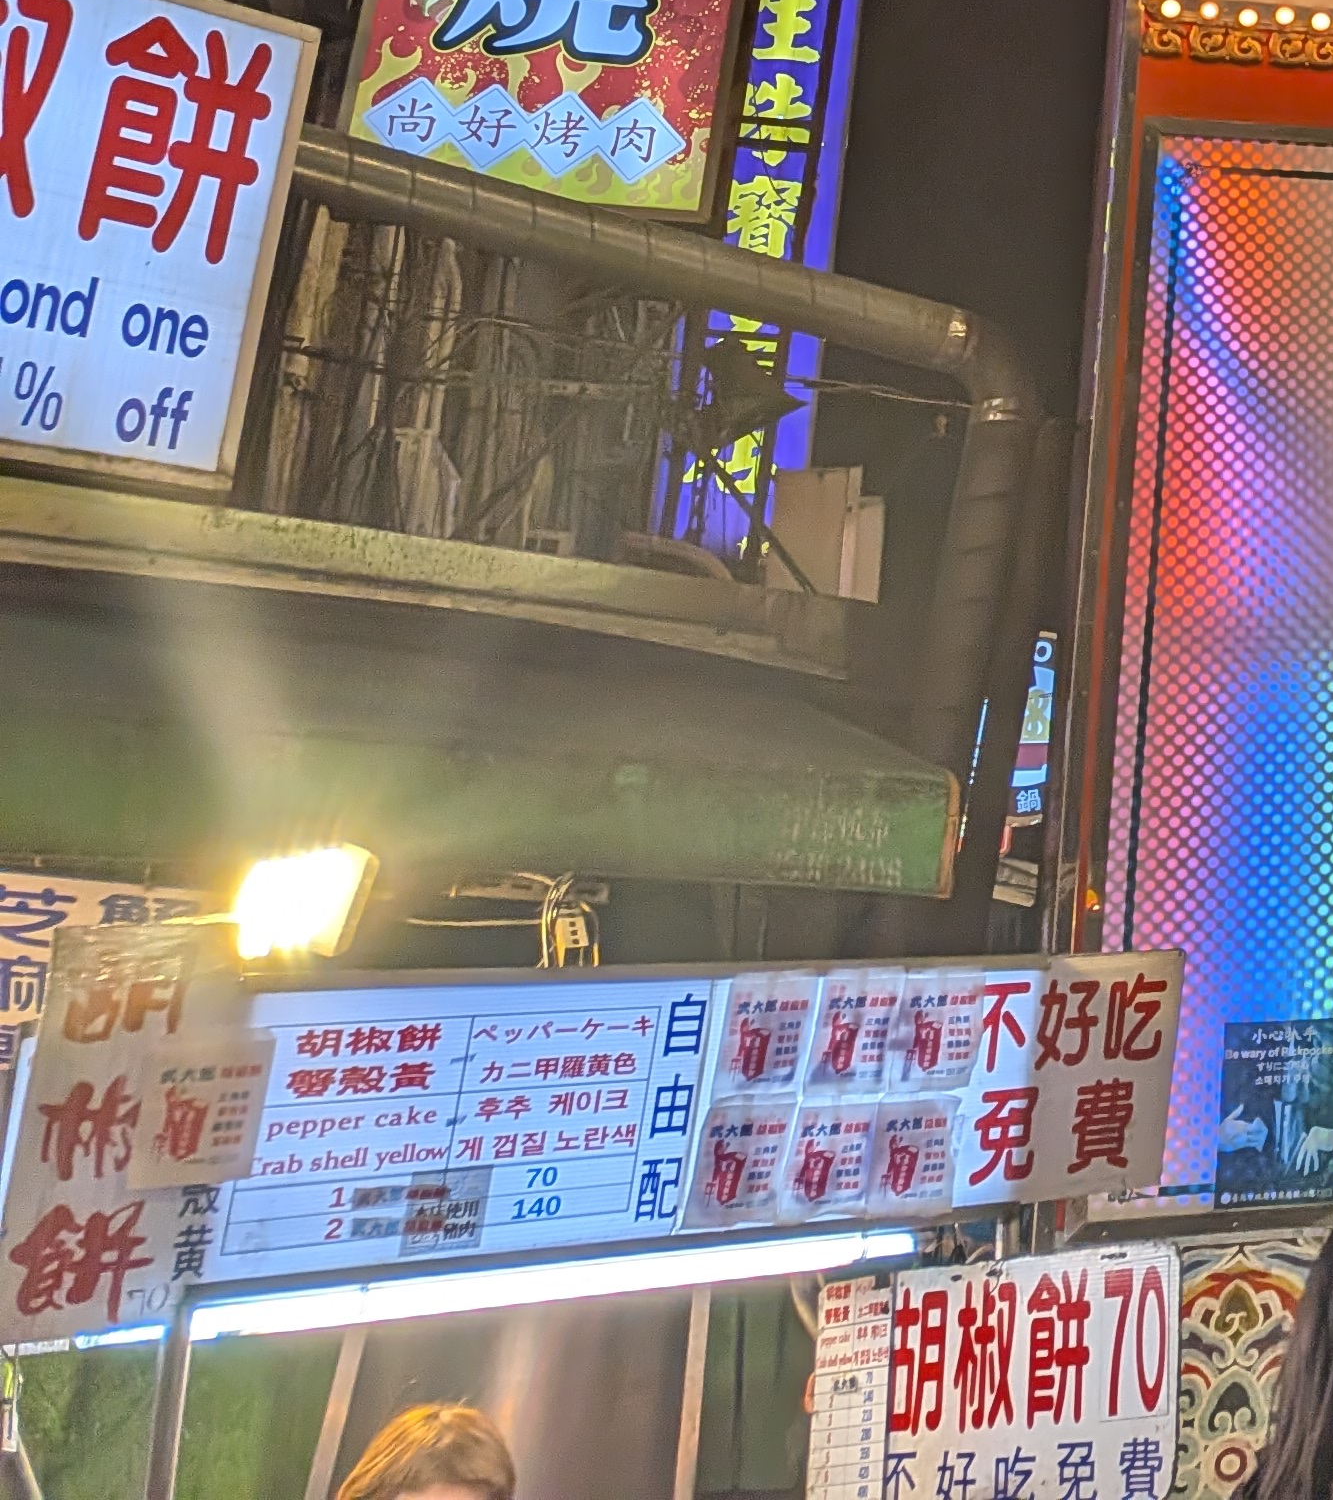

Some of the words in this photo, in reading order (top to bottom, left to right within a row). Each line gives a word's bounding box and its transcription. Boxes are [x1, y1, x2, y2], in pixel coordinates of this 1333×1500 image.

[387, 98, 660, 165] 尚好烤肉
[121, 298, 210, 360] one
[116, 388, 192, 451] off
[296, 1023, 442, 1058] 胡椒餅
[472, 1014, 655, 1045] ペッパーケーキ
[982, 973, 1168, 1074] 不好吃
[479, 1052, 637, 1084] カニ甲羅黄色
[1225, 1049, 1239, 1059] Be
[1241, 1049, 1266, 1060] wary
[1268, 1046, 1279, 1058] of
[285, 1062, 436, 1099] 蟹殼黃
[266, 1114, 365, 1142] pepper
[373, 1105, 438, 1129] cake
[474, 1095, 532, 1123] 후추
[548, 1088, 630, 1116] 케이크
[634, 993, 708, 1223] 自由配
[454, 1135, 484, 1161] 게
[492, 1130, 547, 1160] 껍질
[553, 1123, 638, 1152] 노란색
[967, 1078, 1136, 1187] 免費
[309, 1147, 368, 1171] shell
[373, 1143, 450, 1172] yellow
[526, 1166, 559, 1189] 70
[328, 1187, 345, 1209] 1
[510, 1195, 562, 1221] 140
[324, 1218, 344, 1241] 2
[889, 1267, 1091, 1437] 胡椒餅
[1104, 1265, 1166, 1418] 70
[885, 1437, 1163, 1500] 不好吃免費
